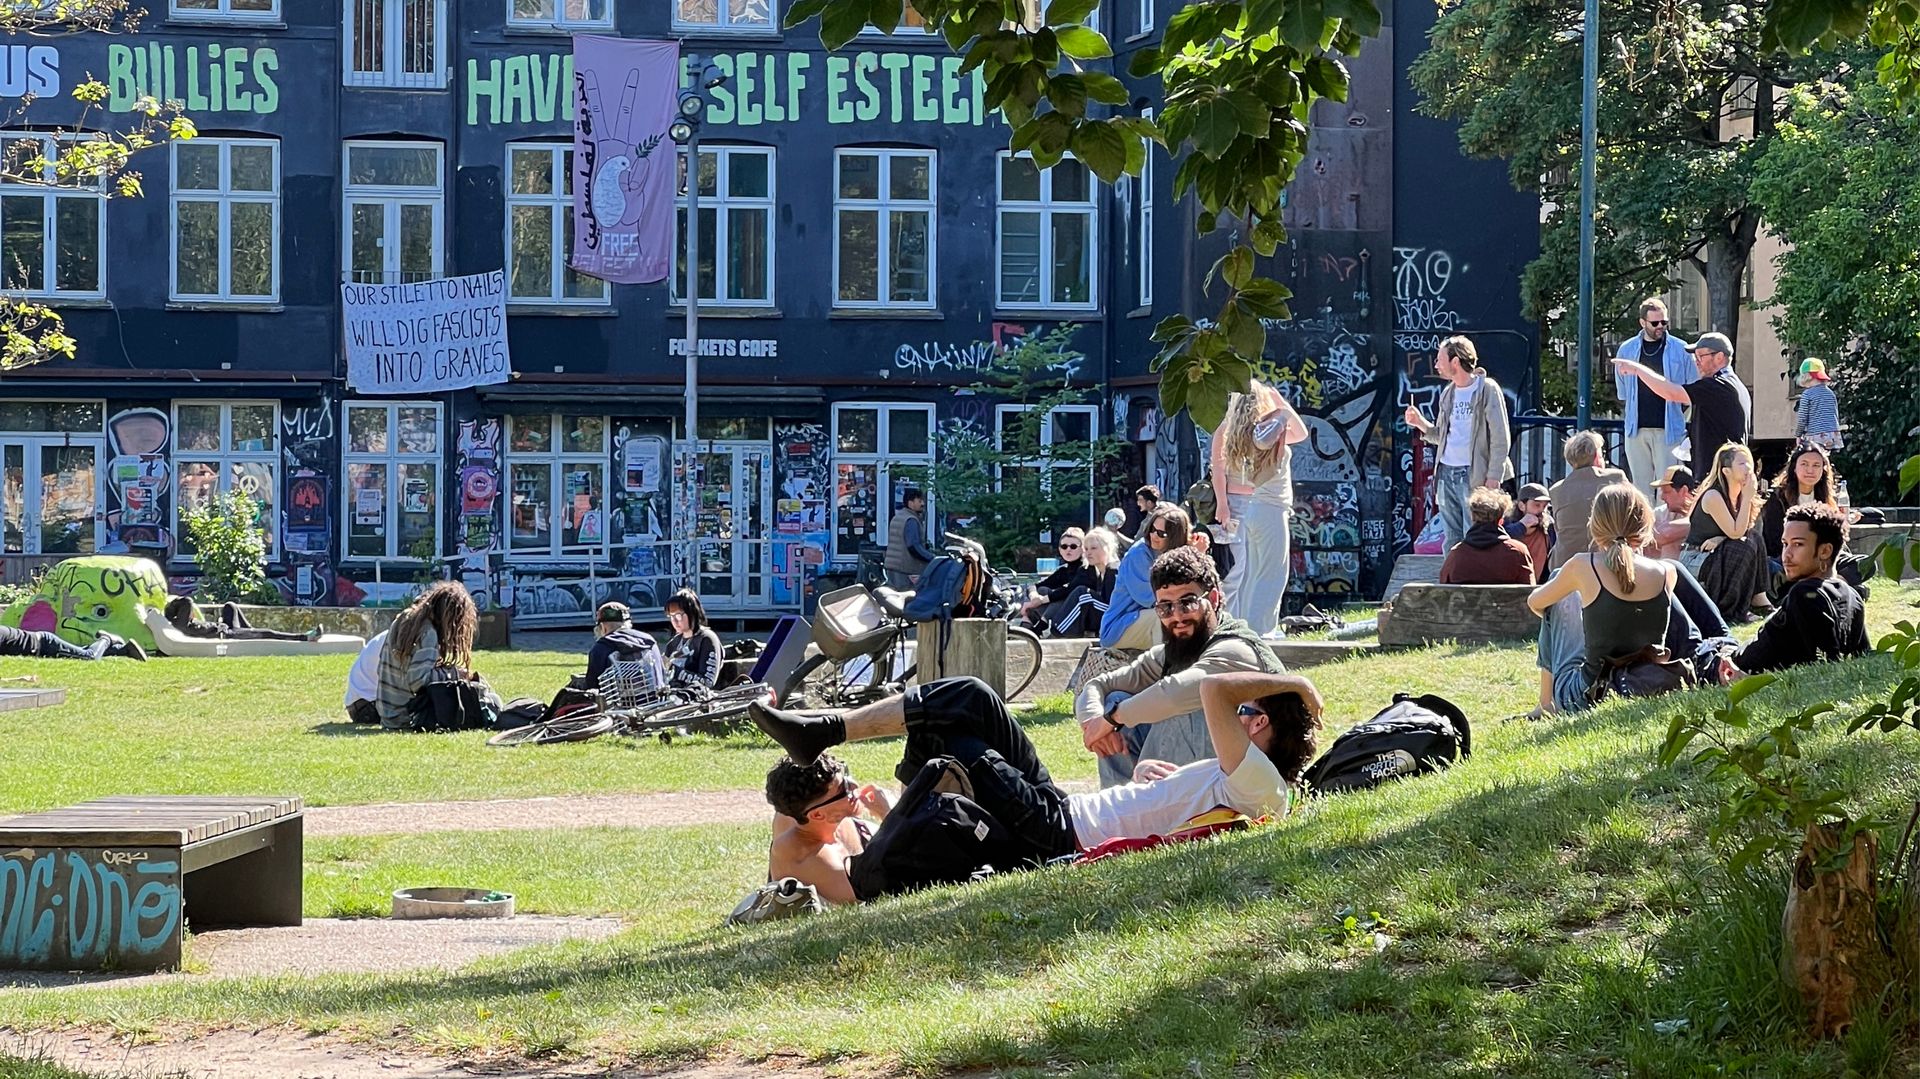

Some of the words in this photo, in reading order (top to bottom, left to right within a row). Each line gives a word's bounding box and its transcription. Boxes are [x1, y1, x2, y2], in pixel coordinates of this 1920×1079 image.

[707, 52, 810, 125] SELF
[601, 232, 640, 256] FREE
[345, 286, 376, 305] OUR
[381, 279, 458, 304] STILETTO
[463, 272, 503, 299] NAILS
[351, 320, 394, 347] WILL
[397, 317, 428, 346] DIG
[433, 305, 501, 343] FASCISTS
[669, 339, 736, 356] FOKETS
[739, 340, 777, 357] CAFE
[376, 351, 423, 384] INTO
[434, 341, 505, 381] GRAVES
[1361, 758, 1396, 773] NORTH
[1375, 750, 1396, 761] THE
[1371, 766, 1397, 779] FACE
